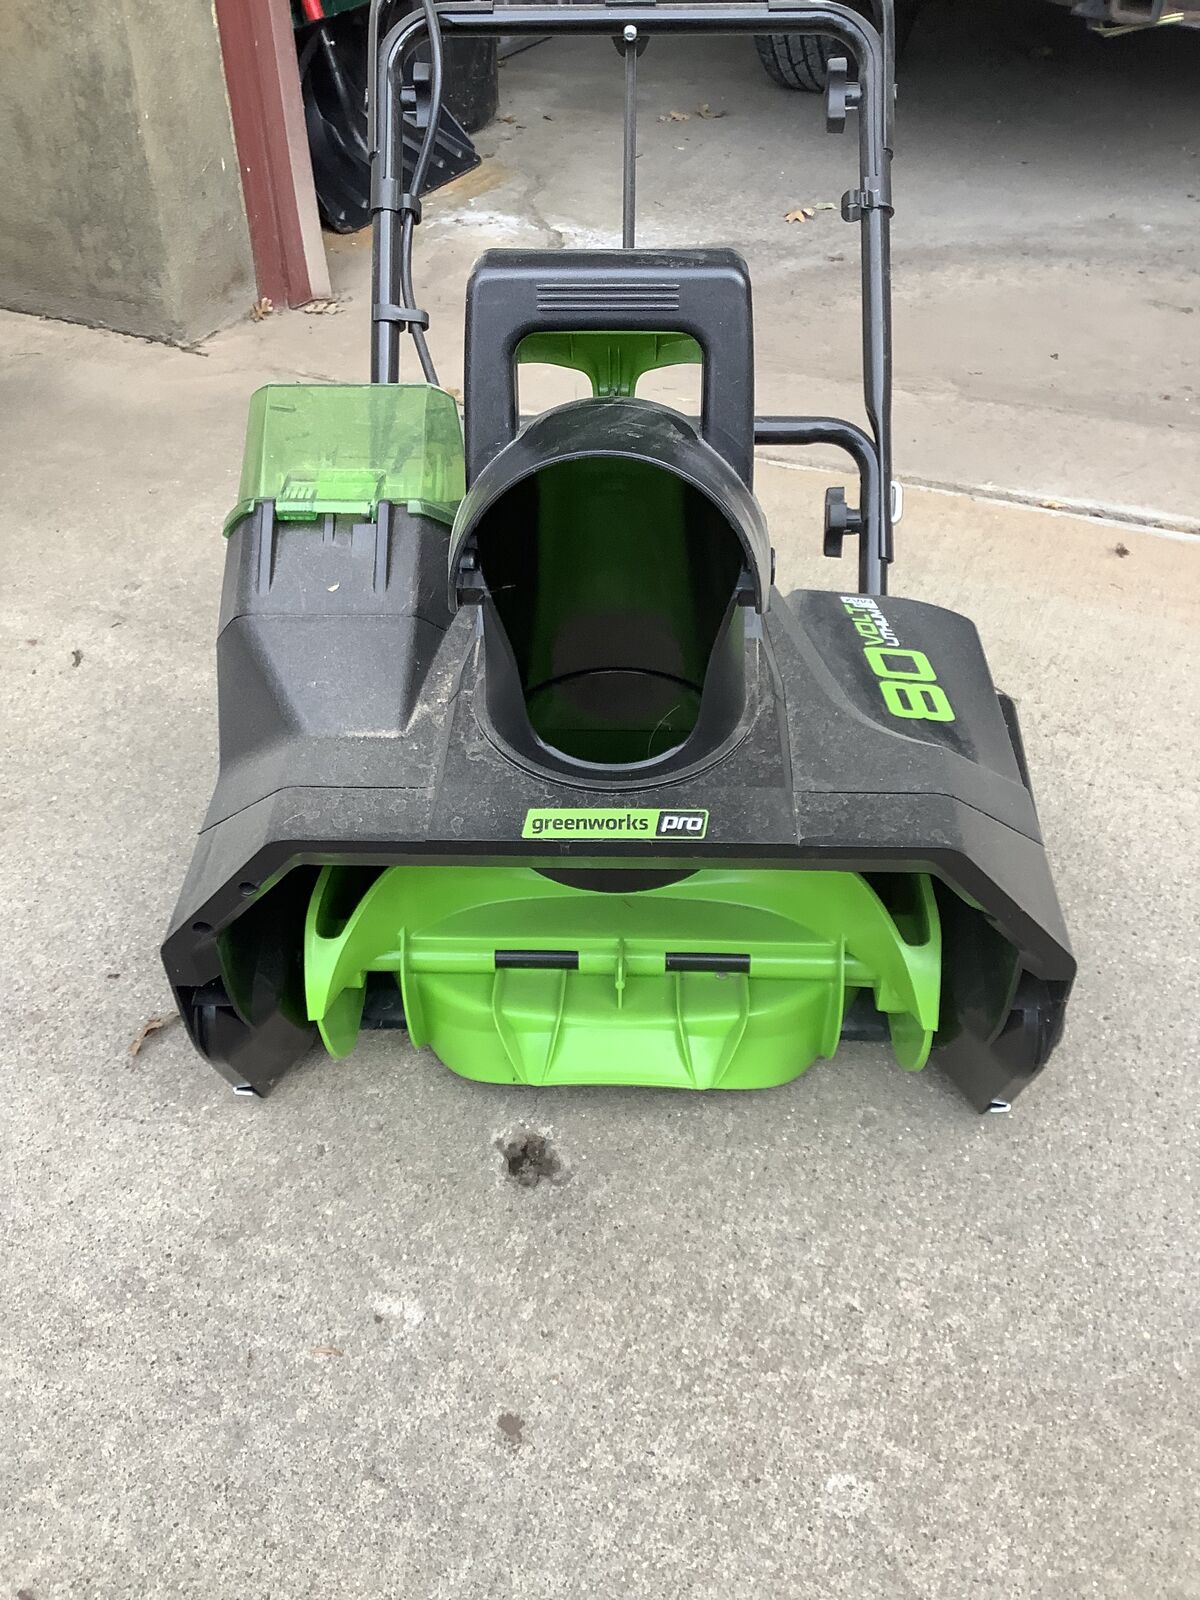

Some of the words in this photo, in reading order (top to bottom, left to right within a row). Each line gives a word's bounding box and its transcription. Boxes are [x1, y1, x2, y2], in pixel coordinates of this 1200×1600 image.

[844, 603, 885, 646] VOLT
[863, 647, 956, 722] 80
[532, 814, 649, 834] greenworks
[661, 815, 703, 833] pro
